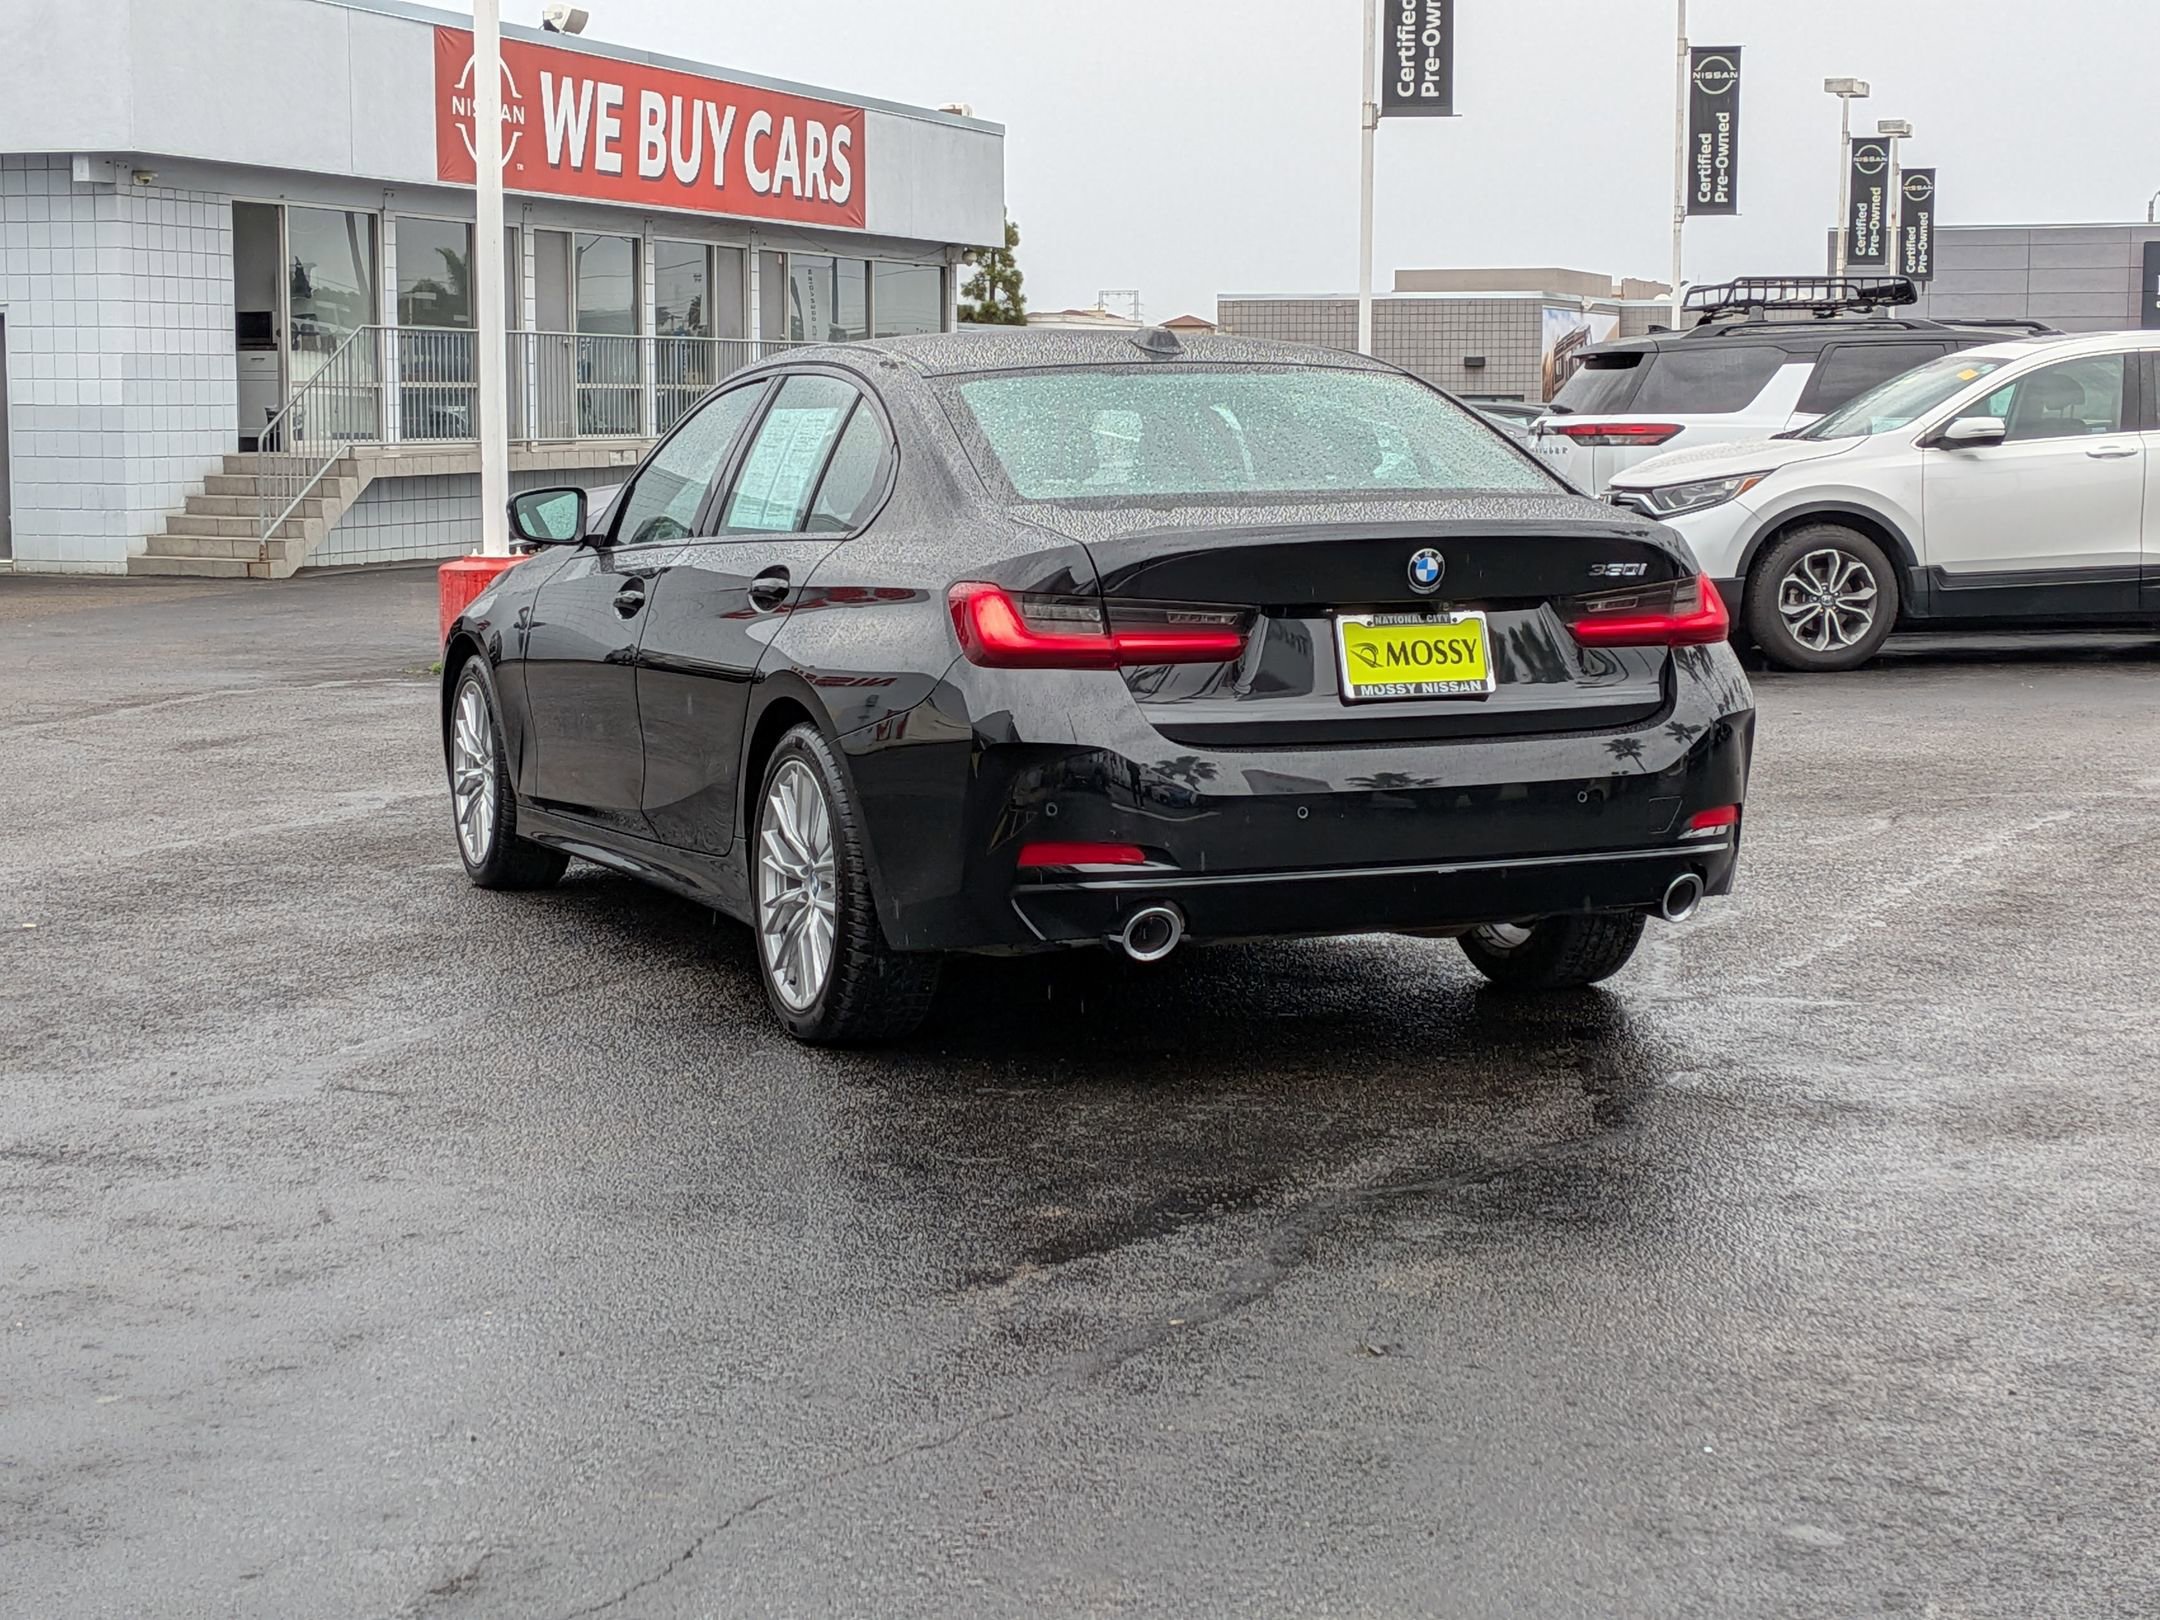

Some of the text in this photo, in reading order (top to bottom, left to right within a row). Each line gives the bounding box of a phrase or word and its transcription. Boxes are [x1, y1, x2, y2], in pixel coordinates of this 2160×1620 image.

[1693, 71, 1738, 80] NISSAN
[452, 96, 525, 125] NIAN
[540, 71, 852, 204] WE BUY CARS
[1715, 112, 1730, 203] Pre-Owned
[1698, 133, 1712, 203] Certified
[1856, 203, 1868, 256] Certified
[1868, 187, 1881, 256] Pre-Owned
[1918, 212, 1928, 273] Pre-Owned
[1906, 226, 1916, 274] Certified
[1374, 612, 1450, 624] NATIONAL CITY
[1386, 638, 1477, 667] MOSSY
[1361, 680, 1482, 696] MOSSY NISSAN
